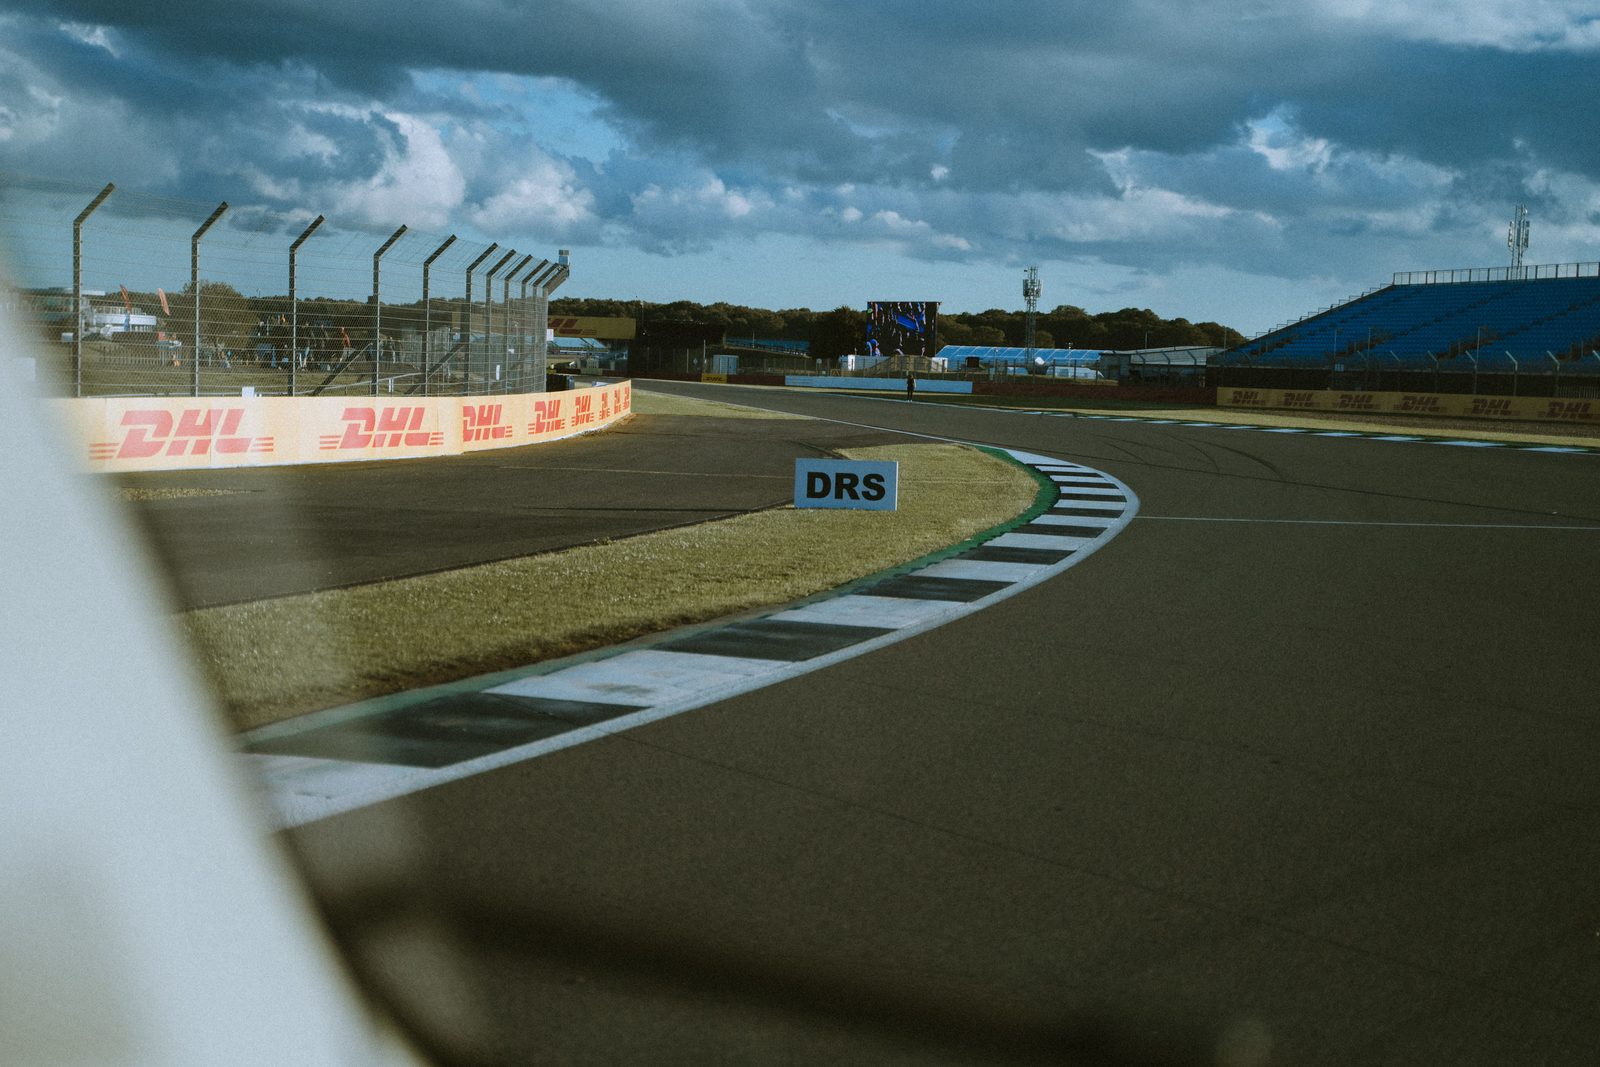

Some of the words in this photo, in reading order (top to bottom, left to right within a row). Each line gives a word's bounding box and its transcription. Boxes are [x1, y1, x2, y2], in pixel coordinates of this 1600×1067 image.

[1232, 390, 1260, 406] DHL
[1283, 392, 1313, 407] DHL
[1339, 394, 1373, 409] DHL
[1400, 395, 1440, 412] DHL
[1471, 398, 1512, 416] DHL
[534, 399, 561, 434] DHL
[1545, 401, 1593, 419] DHL
[339, 407, 436, 449] DHL
[462, 405, 506, 442] DHL
[115, 408, 252, 459] DHL
[807, 472, 886, 501] DRS
